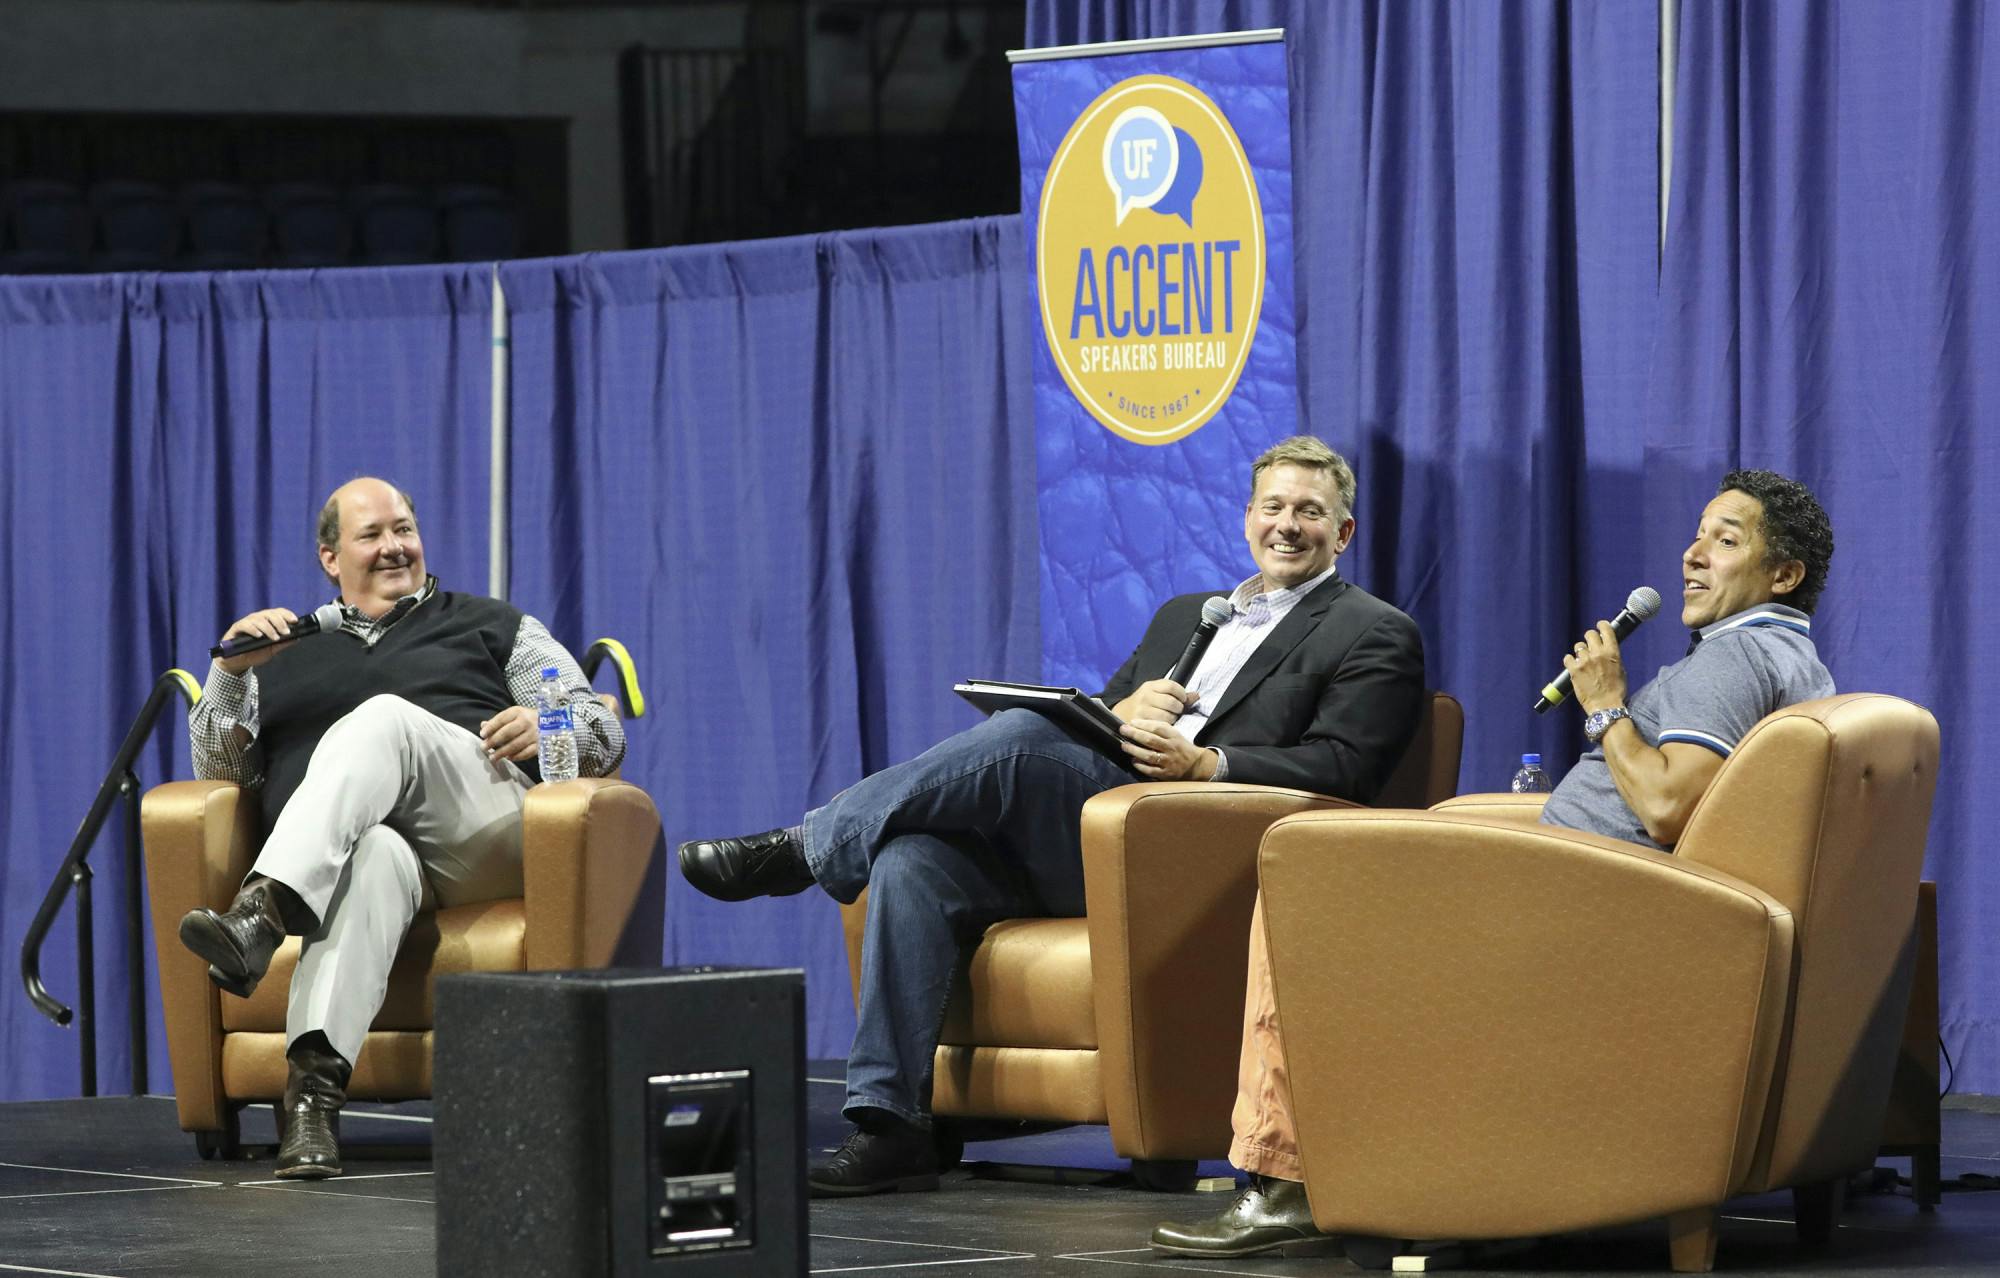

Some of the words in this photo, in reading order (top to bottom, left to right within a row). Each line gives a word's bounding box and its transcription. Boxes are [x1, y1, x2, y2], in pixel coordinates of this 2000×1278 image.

[1122, 138, 1157, 180] UF
[1070, 240, 1240, 339] ACCENT
[1080, 343, 1157, 373] SPEAKERS
[1163, 341, 1226, 369] BUREAU
[1118, 396, 1156, 419] SINCE
[1162, 395, 1190, 417] 1967
